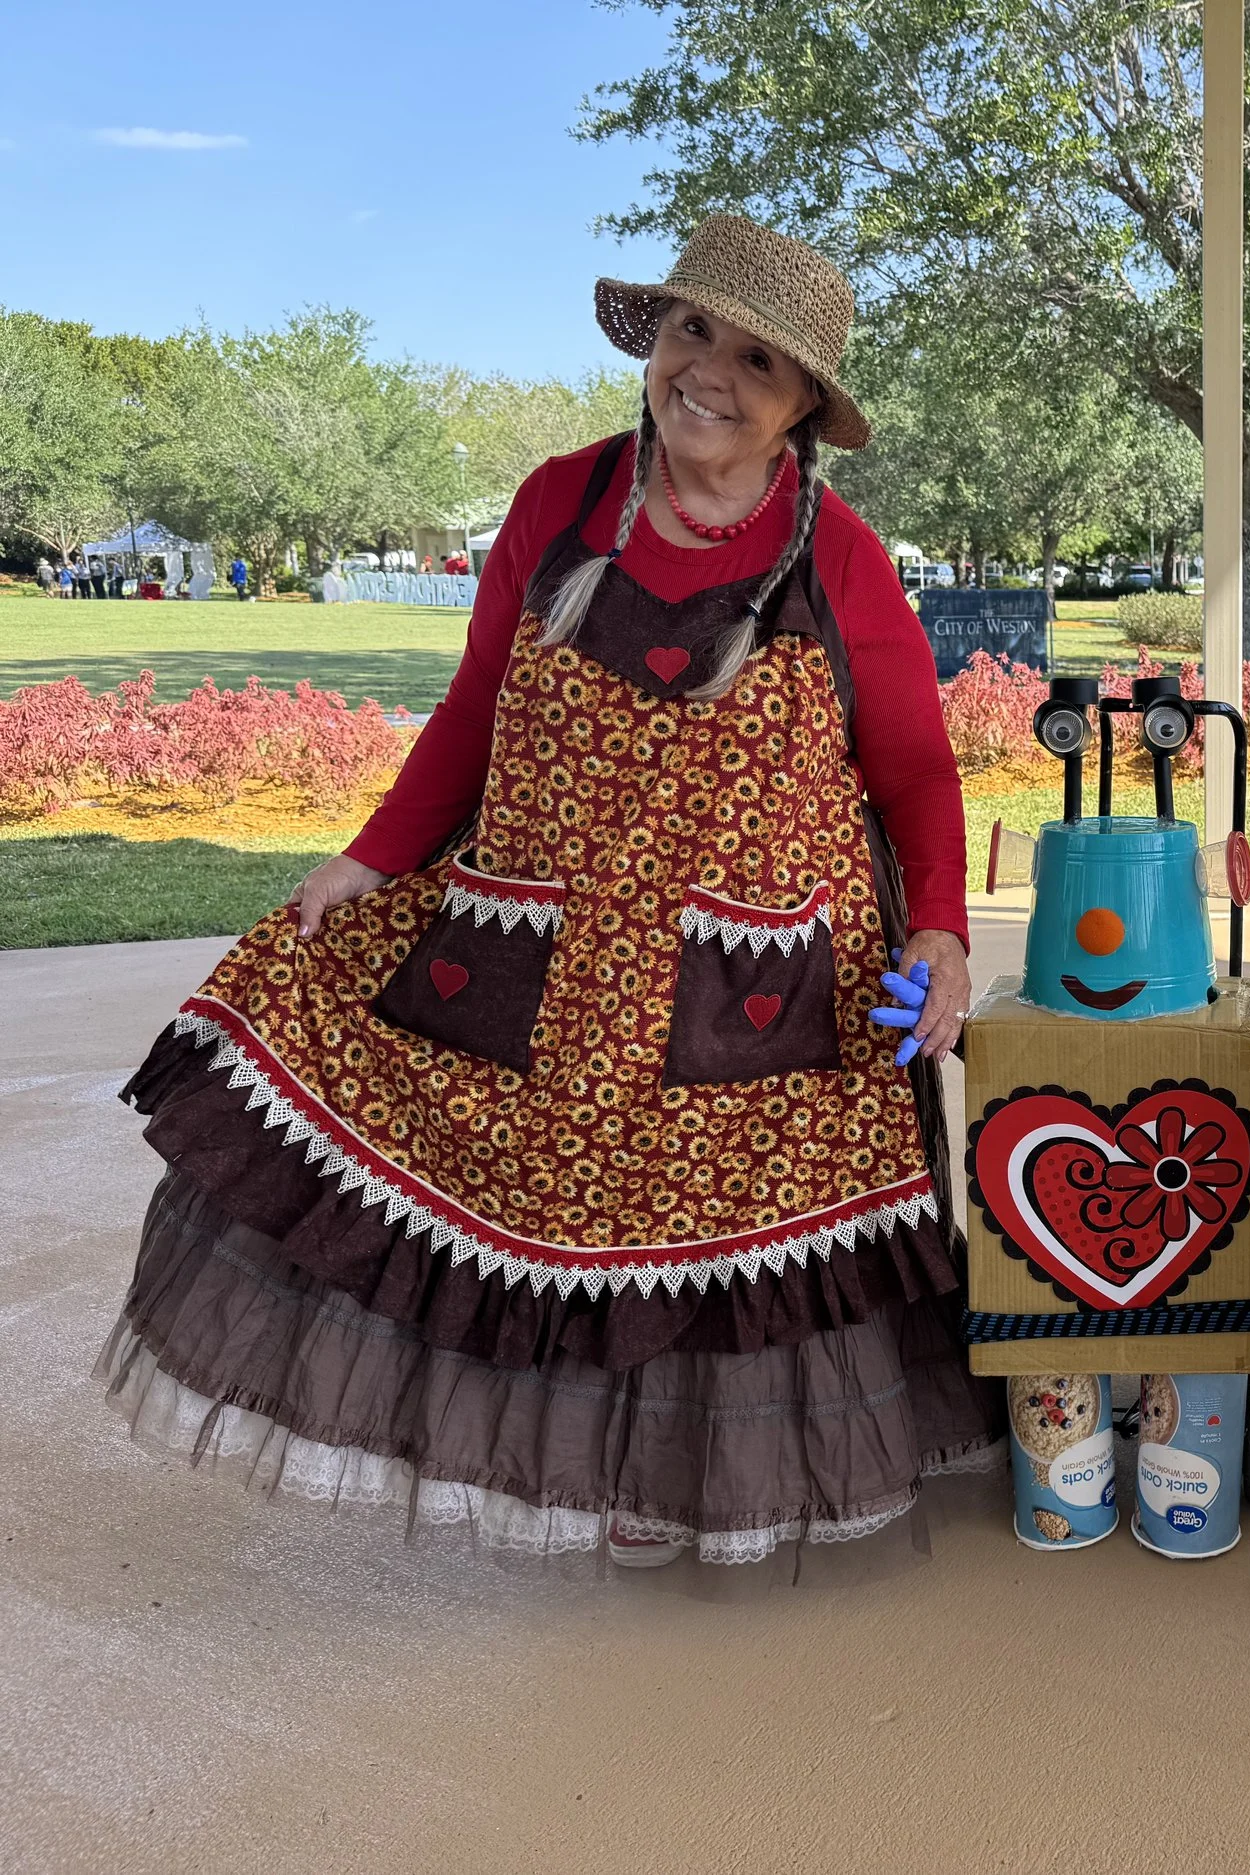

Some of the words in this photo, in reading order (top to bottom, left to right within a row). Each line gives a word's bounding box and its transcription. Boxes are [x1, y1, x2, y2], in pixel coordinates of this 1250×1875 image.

[979, 608, 994, 618] THE
[934, 618, 965, 636] CITY
[967, 620, 983, 635] OF
[986, 617, 1036, 635] WESTON
[1062, 1460, 1086, 1471] Grain
[1097, 1456, 1113, 1475] ick
[1156, 1464, 1181, 1478] Whole
[1061, 1468, 1094, 1486] Oats
[1141, 1465, 1162, 1488] Oats
[1182, 1470, 1204, 1480] 100%
[1166, 1478, 1208, 1495] Quick
[1172, 1515, 1202, 1528] Great
[1173, 1510, 1195, 1519] Value
